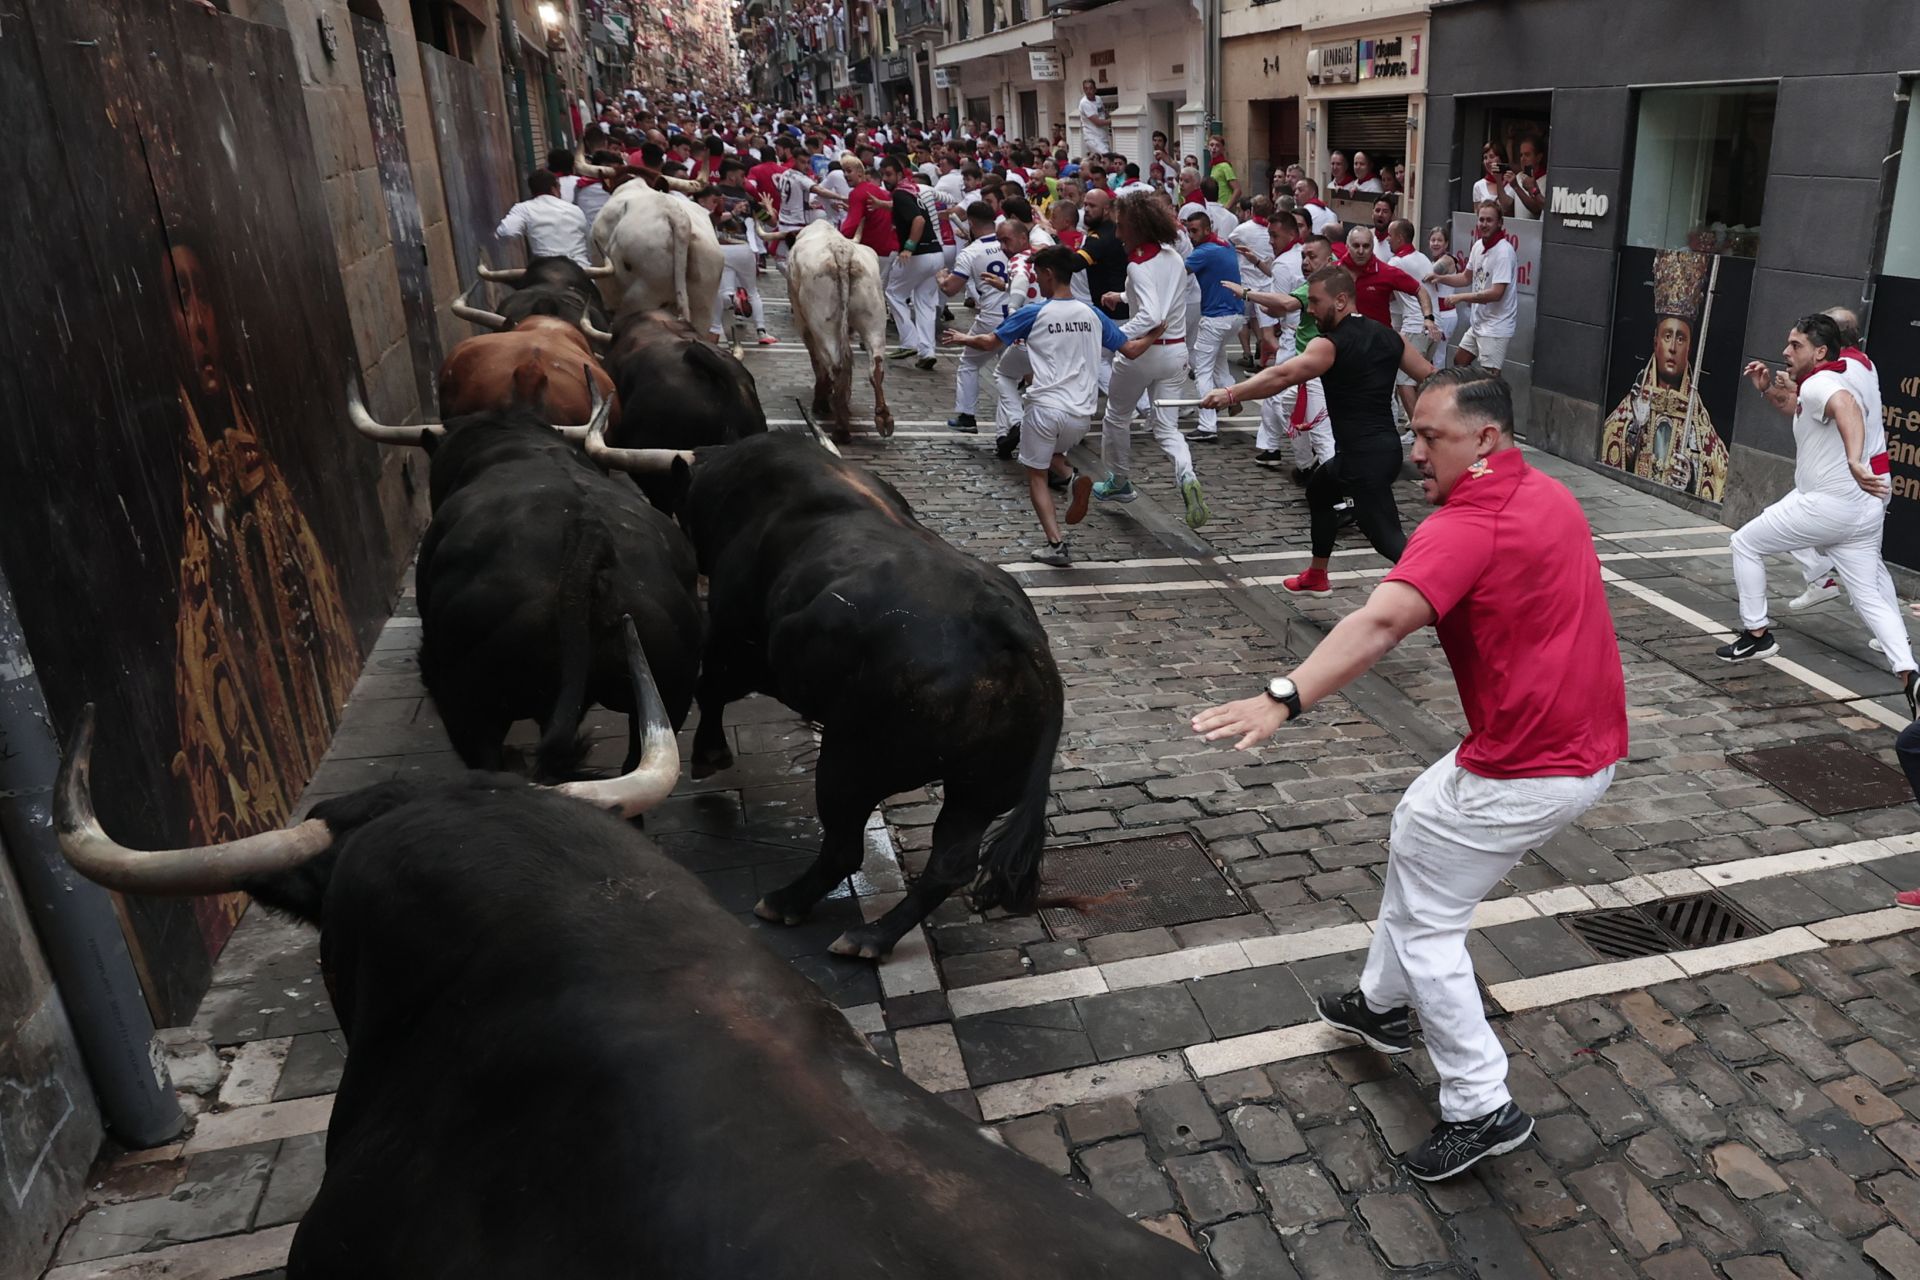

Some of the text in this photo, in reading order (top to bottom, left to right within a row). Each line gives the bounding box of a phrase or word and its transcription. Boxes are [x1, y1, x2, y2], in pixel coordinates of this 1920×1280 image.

[1375, 58, 1408, 77] colores
[1550, 186, 1609, 217] Mucho
[1562, 218, 1593, 229] PAMPLONA
[1048, 323, 1064, 334] C.D.
